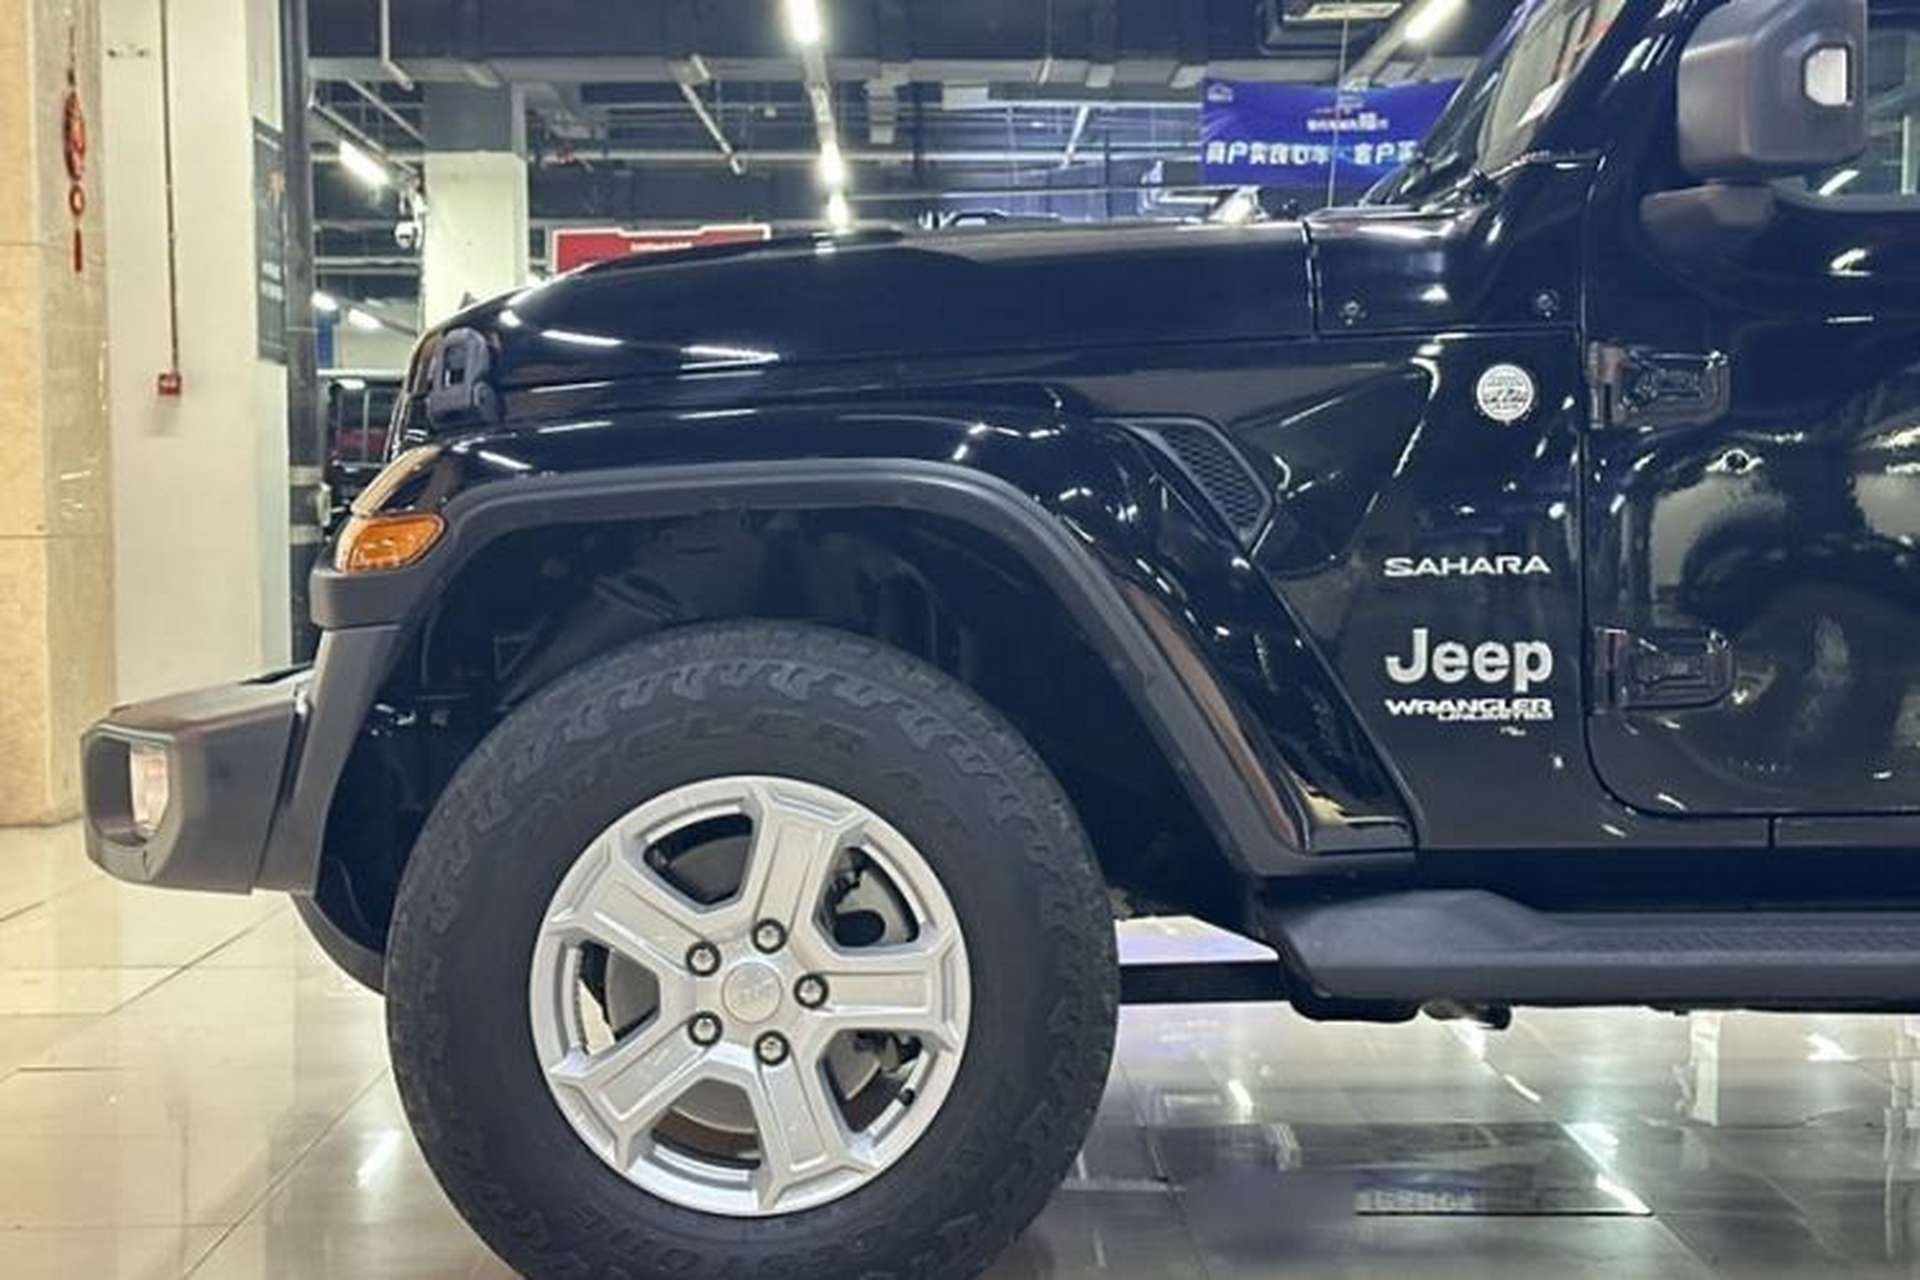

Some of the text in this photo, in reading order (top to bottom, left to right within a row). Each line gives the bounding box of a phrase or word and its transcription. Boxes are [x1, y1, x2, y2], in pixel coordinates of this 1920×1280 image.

[1384, 555, 1551, 577] SAHARA
[1385, 627, 1554, 693] Jeep
[1384, 698, 1553, 716] WRANGLER
